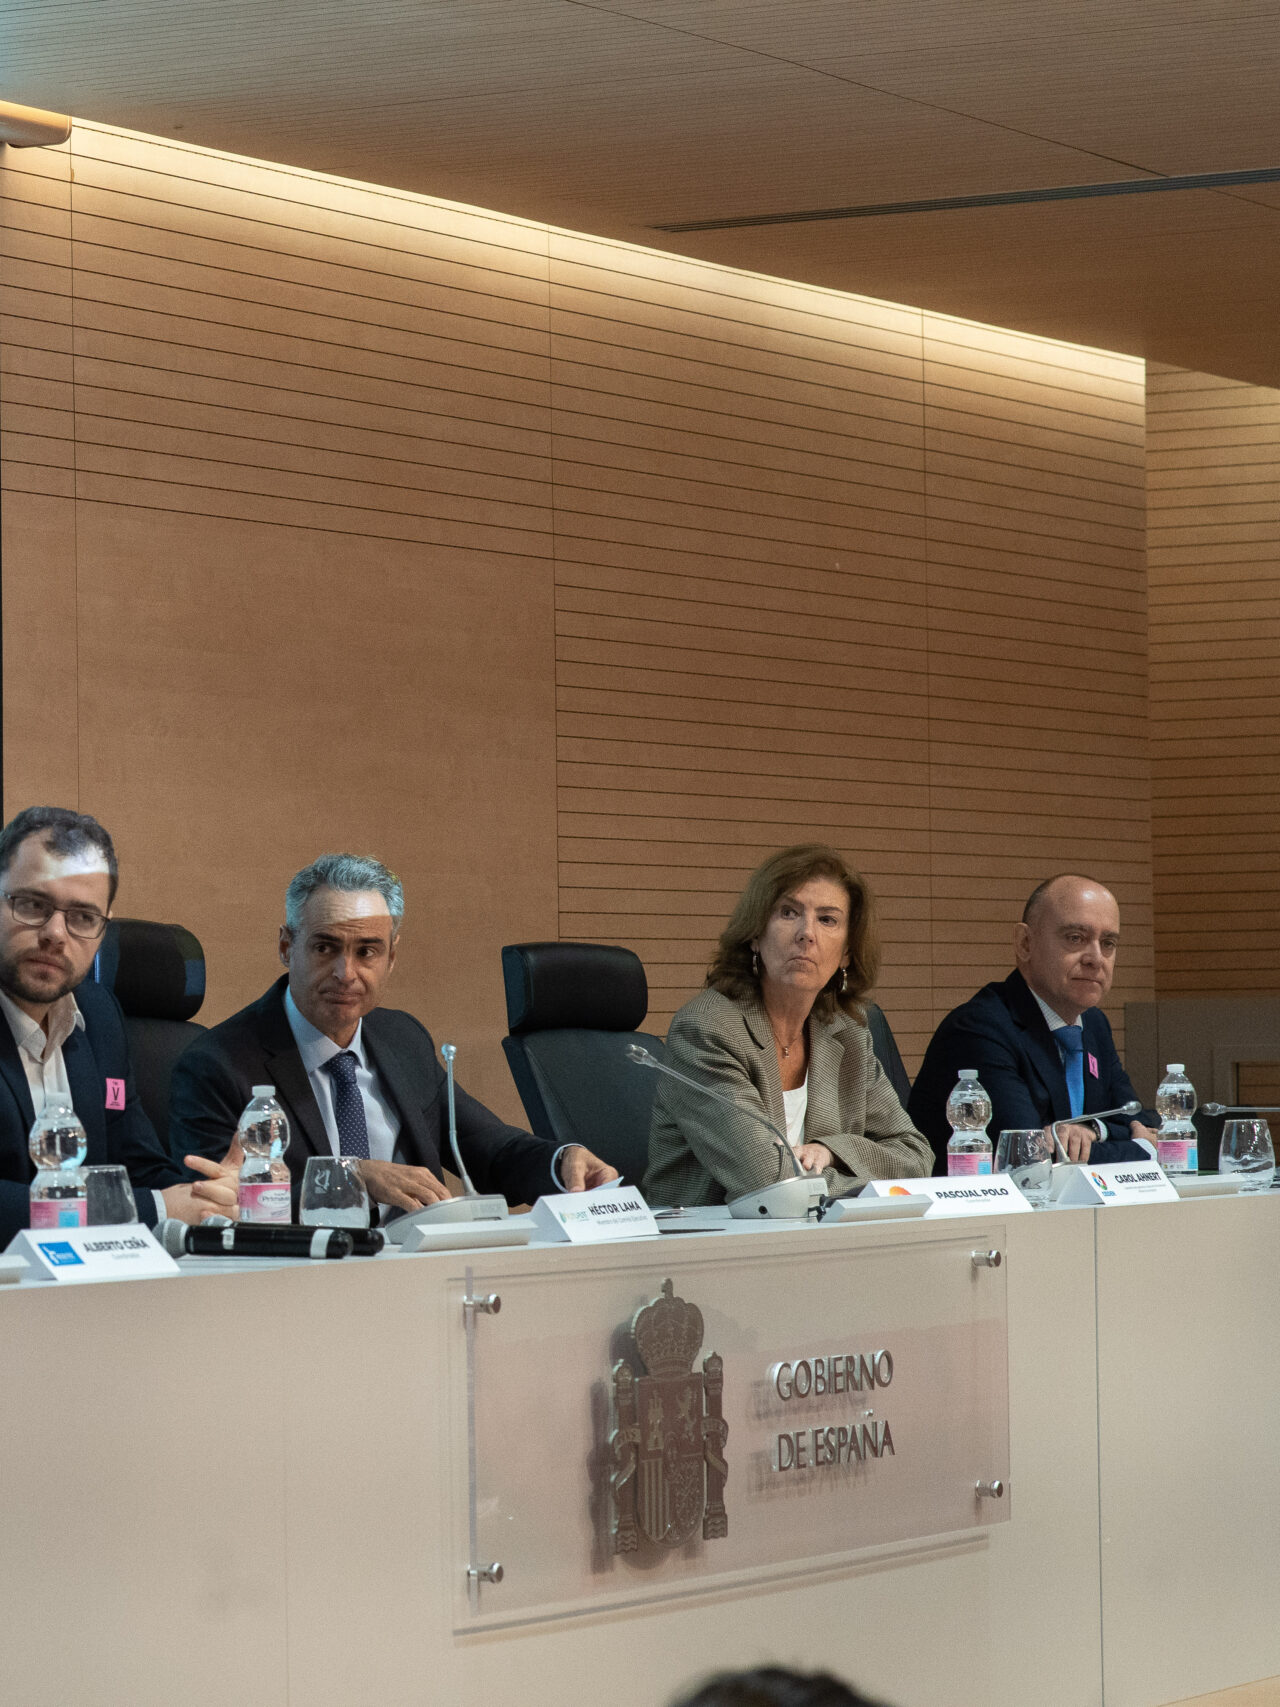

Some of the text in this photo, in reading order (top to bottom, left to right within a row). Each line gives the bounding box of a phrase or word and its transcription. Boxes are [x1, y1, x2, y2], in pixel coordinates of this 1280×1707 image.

[935, 1187, 1009, 1199] PASCUAL POLO
[588, 1201, 642, 1216] HÉCTOR LAMA
[83, 1237, 151, 1254] ALBERTO CEÑA
[775, 1350, 893, 1401] GOBIERNO
[777, 1408, 895, 1472] DE ESPAÑA
